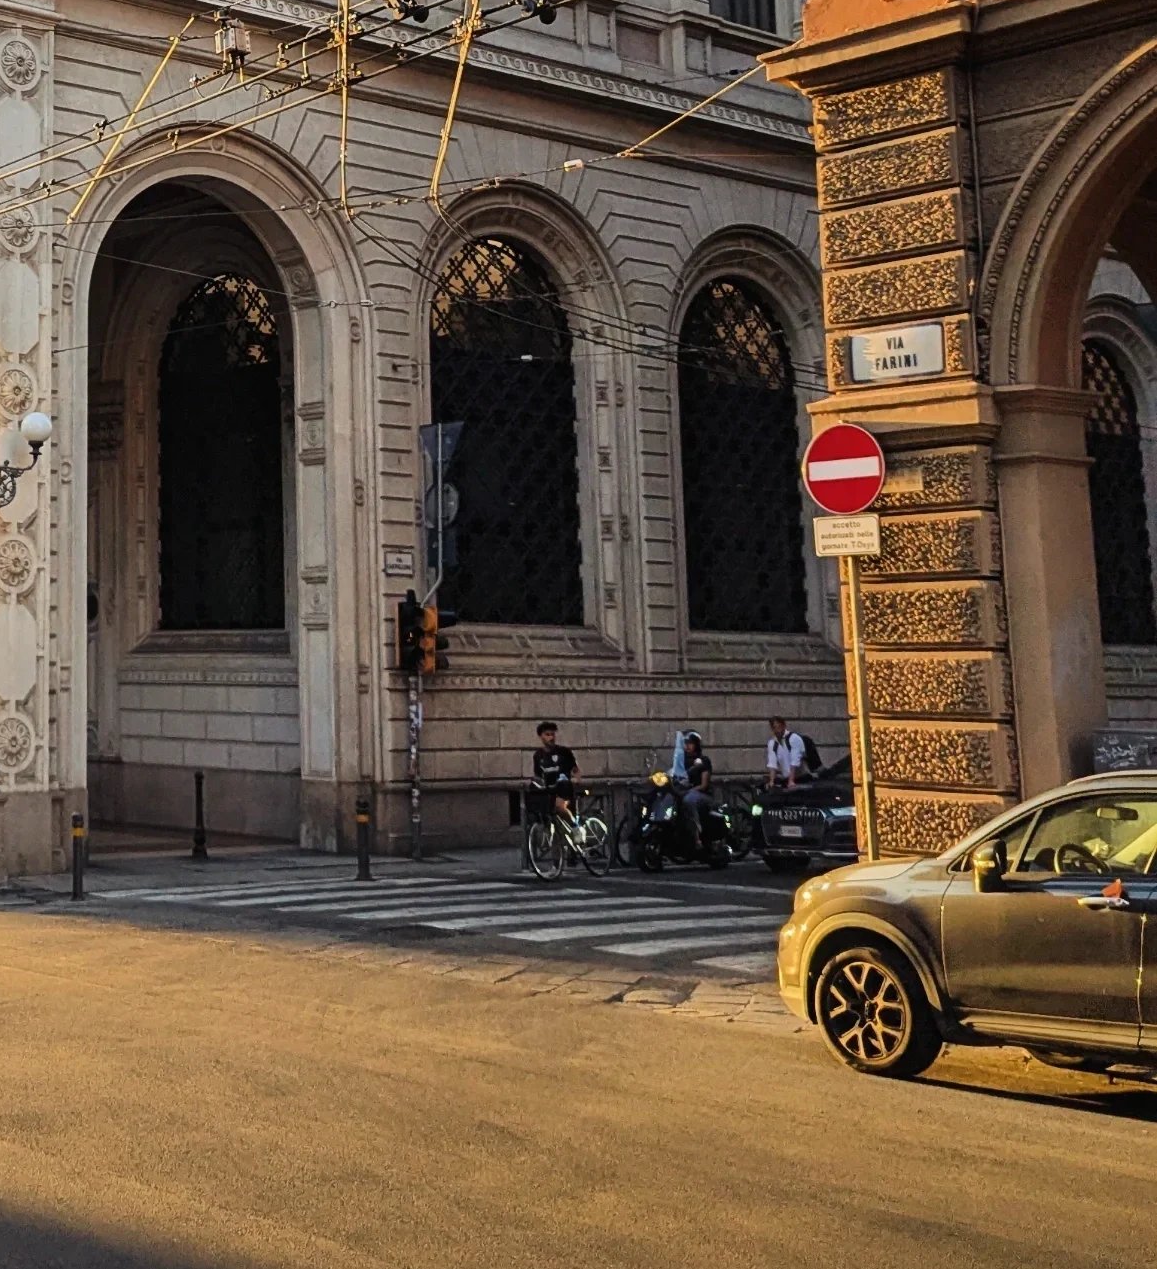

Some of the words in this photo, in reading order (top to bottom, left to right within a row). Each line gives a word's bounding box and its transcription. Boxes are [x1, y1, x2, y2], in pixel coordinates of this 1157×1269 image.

[886, 336, 904, 350] VIA
[875, 353, 918, 371] FARINI
[832, 521, 861, 529] eccetto
